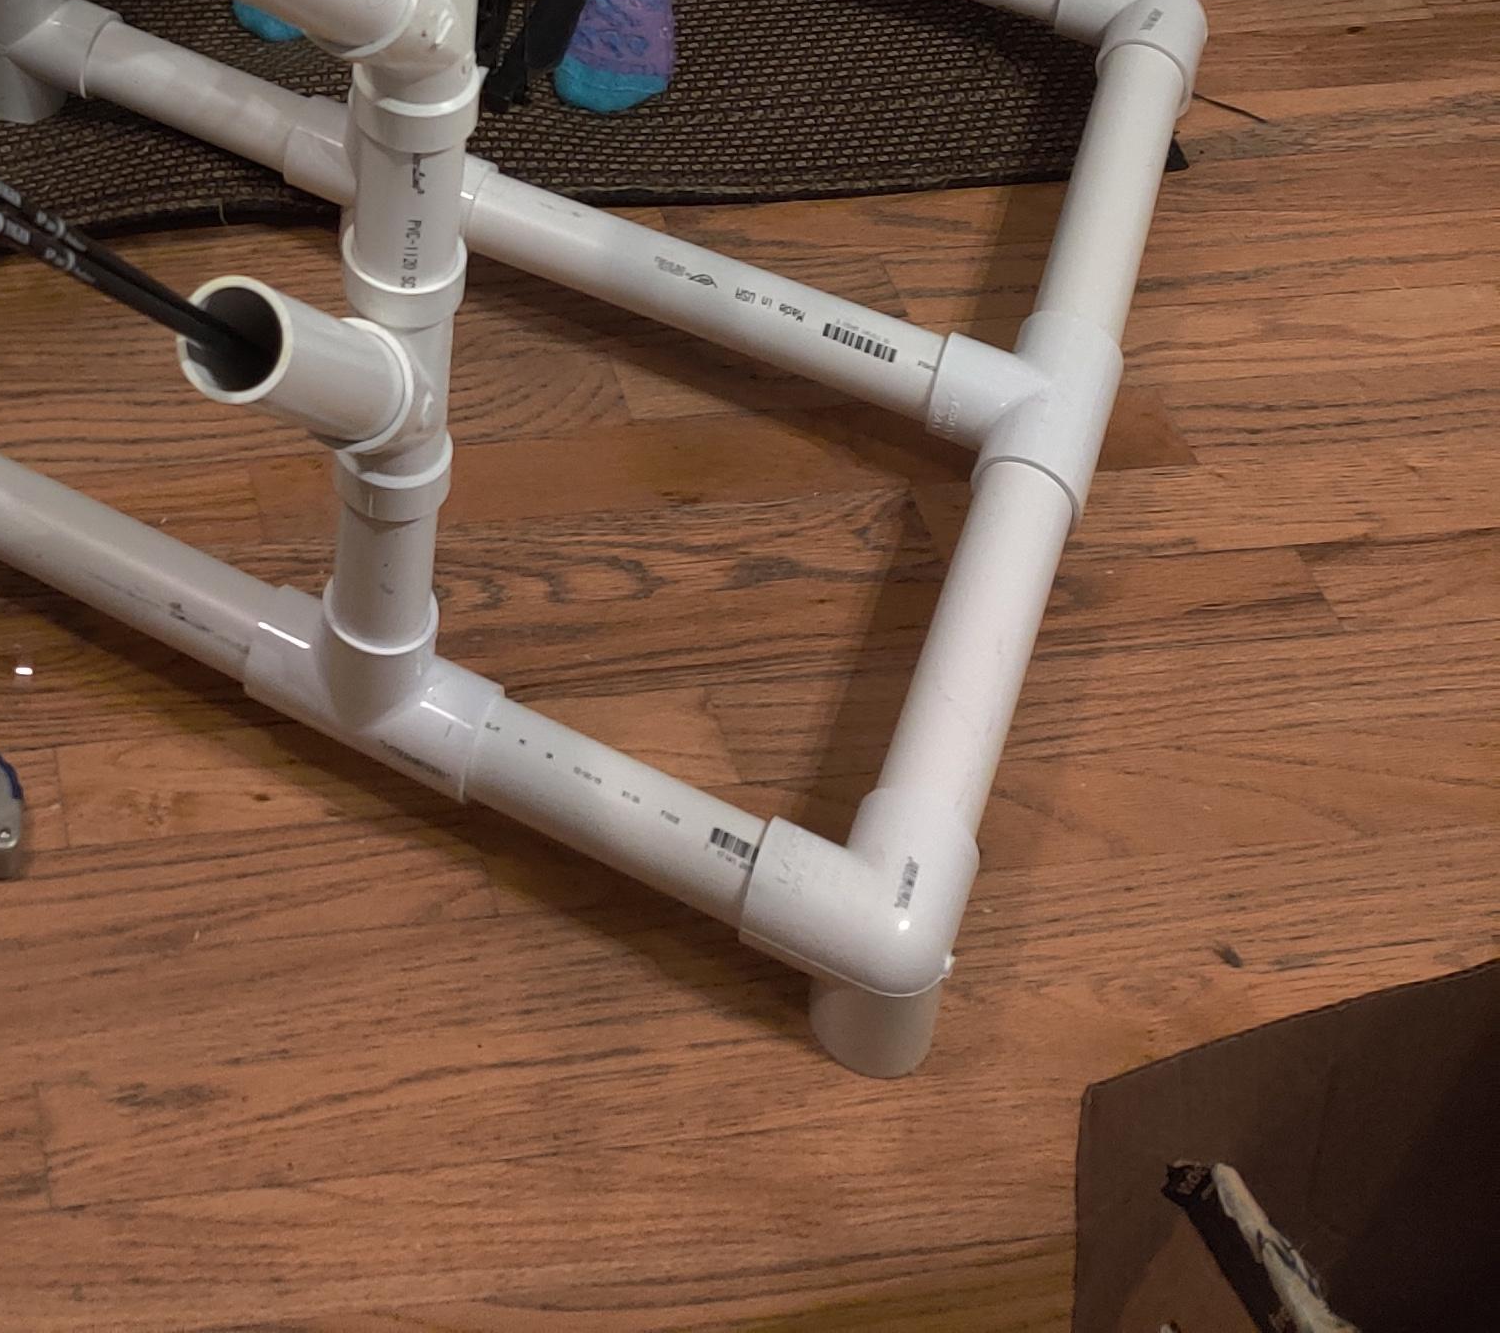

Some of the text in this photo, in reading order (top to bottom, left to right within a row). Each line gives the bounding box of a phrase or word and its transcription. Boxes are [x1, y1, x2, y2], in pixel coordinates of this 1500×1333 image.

[734, 286, 806, 323] Made in USA
